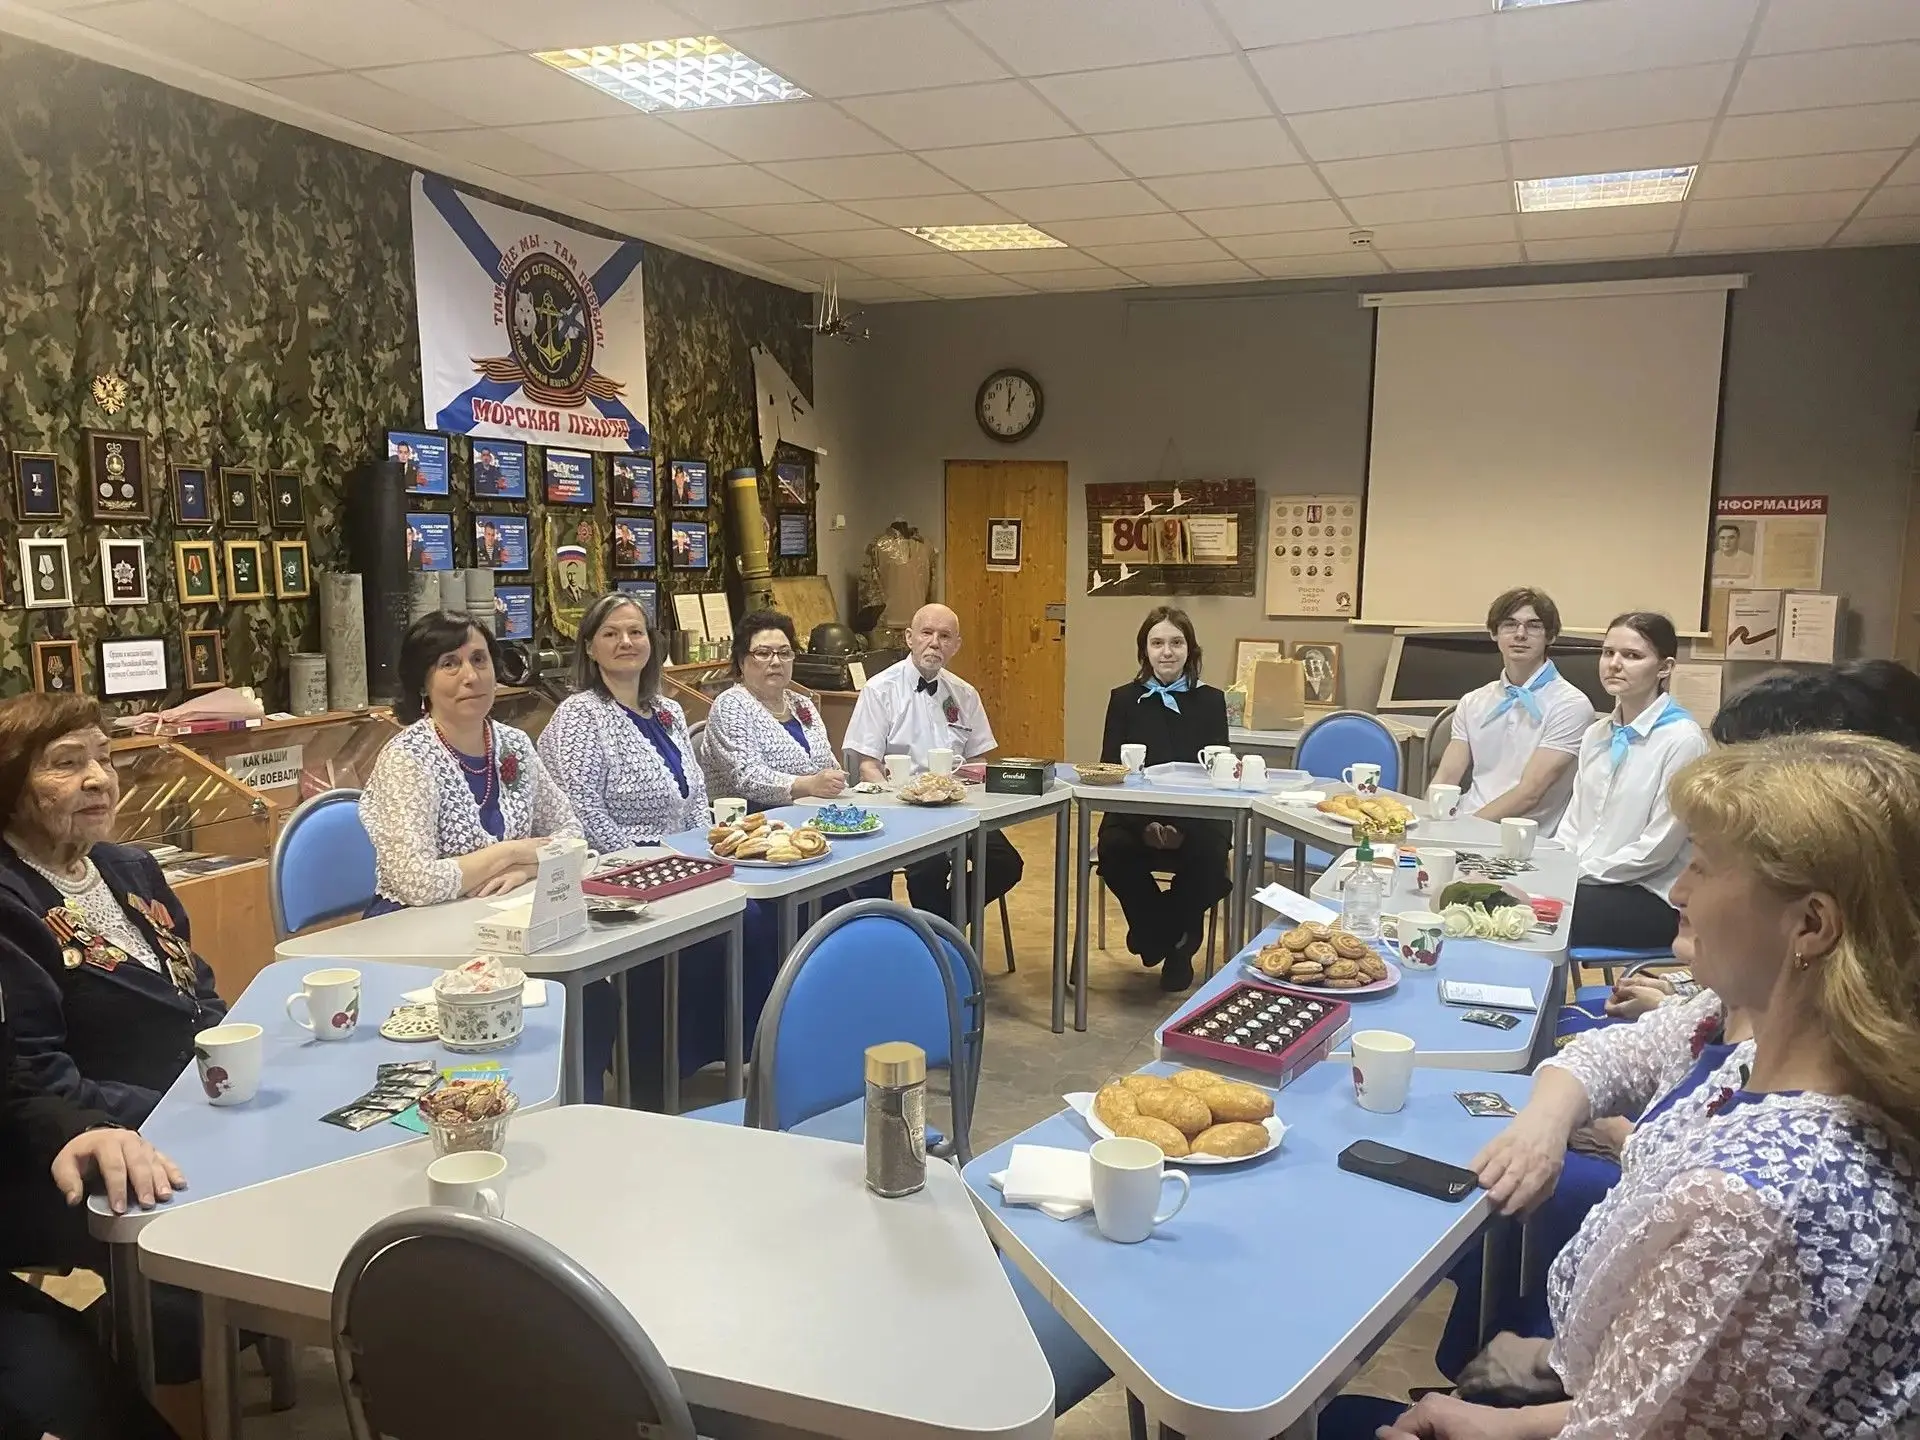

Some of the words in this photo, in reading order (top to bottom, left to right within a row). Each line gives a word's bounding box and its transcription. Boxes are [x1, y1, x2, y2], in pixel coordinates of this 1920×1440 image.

[519, 234, 540, 252] МЫ
[553, 240, 578, 270] ТАМ
[519, 271, 531, 287] 40
[473, 398, 561, 432] МОРСКАЯ
[568, 413, 629, 439] ПЕХОТА
[1718, 500, 1822, 511] НФОРМАЦИЯ
[1114, 518, 1150, 551] 80
[243, 754, 260, 768] КАК
[262, 750, 288, 764] НАШИ
[260, 769, 300, 785] ВОЕВАЛИ
